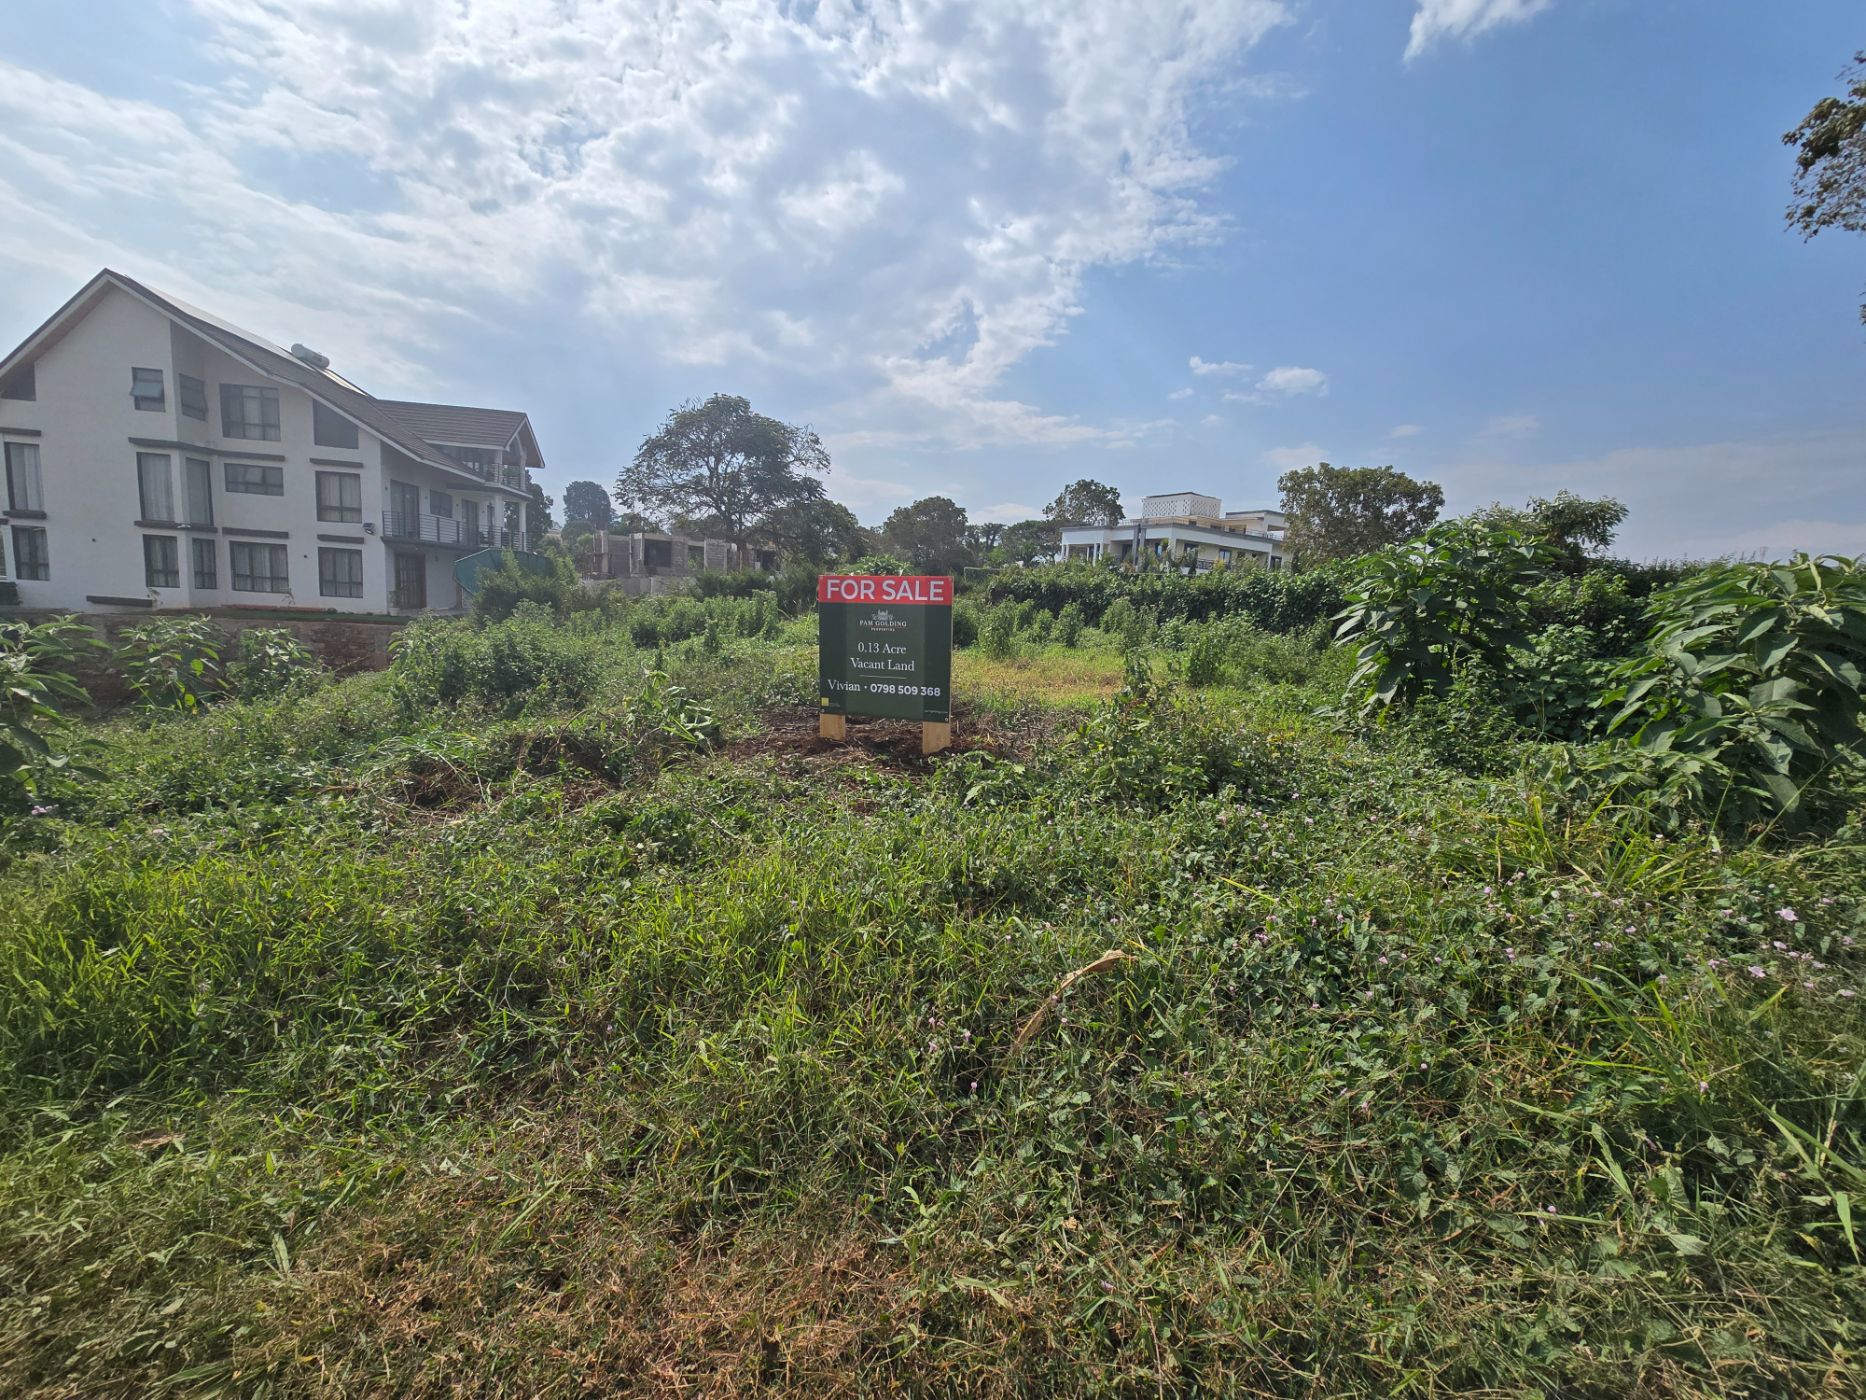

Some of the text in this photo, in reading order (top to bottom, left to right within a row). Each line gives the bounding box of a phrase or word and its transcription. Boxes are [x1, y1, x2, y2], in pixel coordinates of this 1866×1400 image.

[827, 579, 944, 601] FOR SALE
[875, 620, 907, 628] GOLDING
[858, 641, 907, 654] 0.13 Acre
[850, 657, 915, 672] Vacant Land
[828, 679, 941, 697] Vivian 0798 509 368
